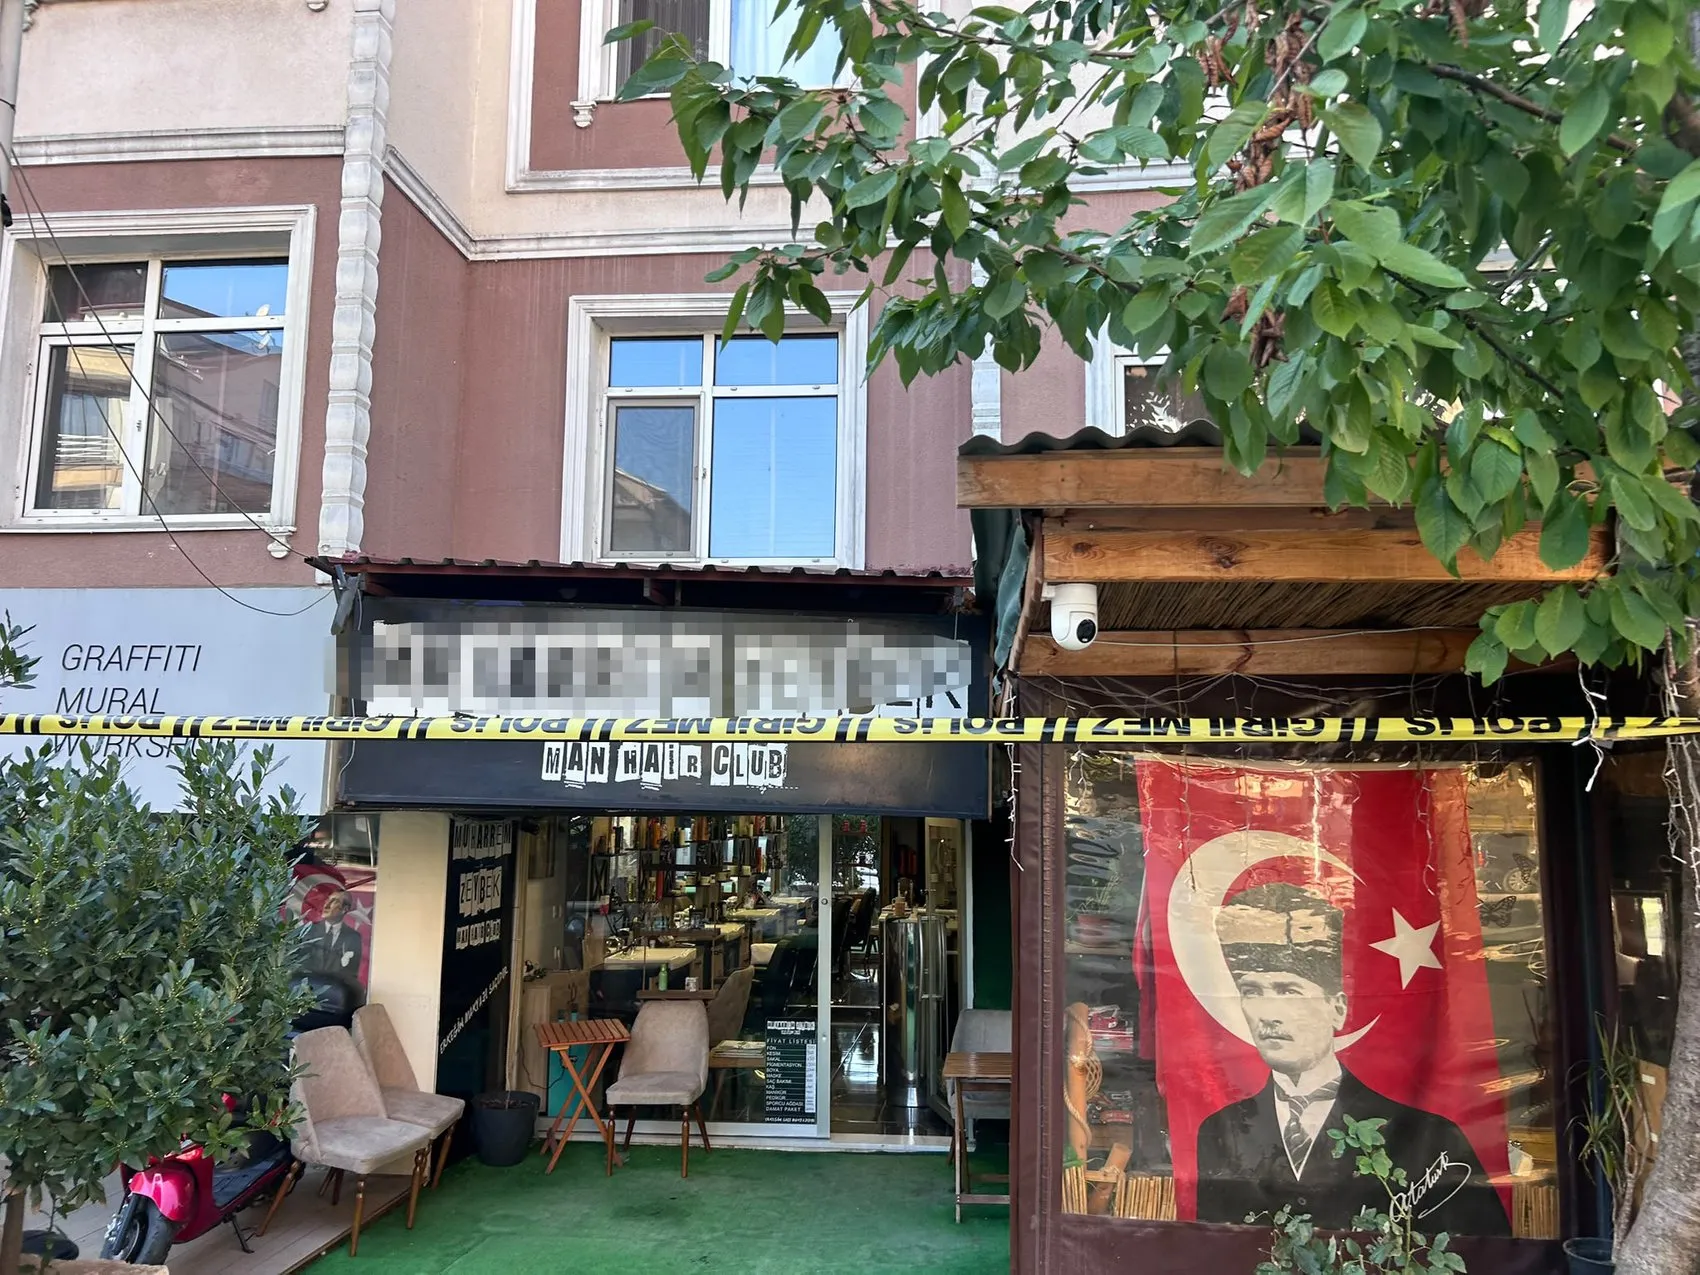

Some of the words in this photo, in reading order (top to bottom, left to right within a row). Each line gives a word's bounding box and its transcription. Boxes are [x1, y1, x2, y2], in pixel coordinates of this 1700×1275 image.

[62, 643, 202, 672] GRAFFITI
[55, 687, 166, 714] MURAL
[544, 742, 606, 778] MAN
[712, 743, 784, 780] CLUB
[453, 822, 511, 850] MUHARREM
[460, 872, 501, 905] ZEYBEK
